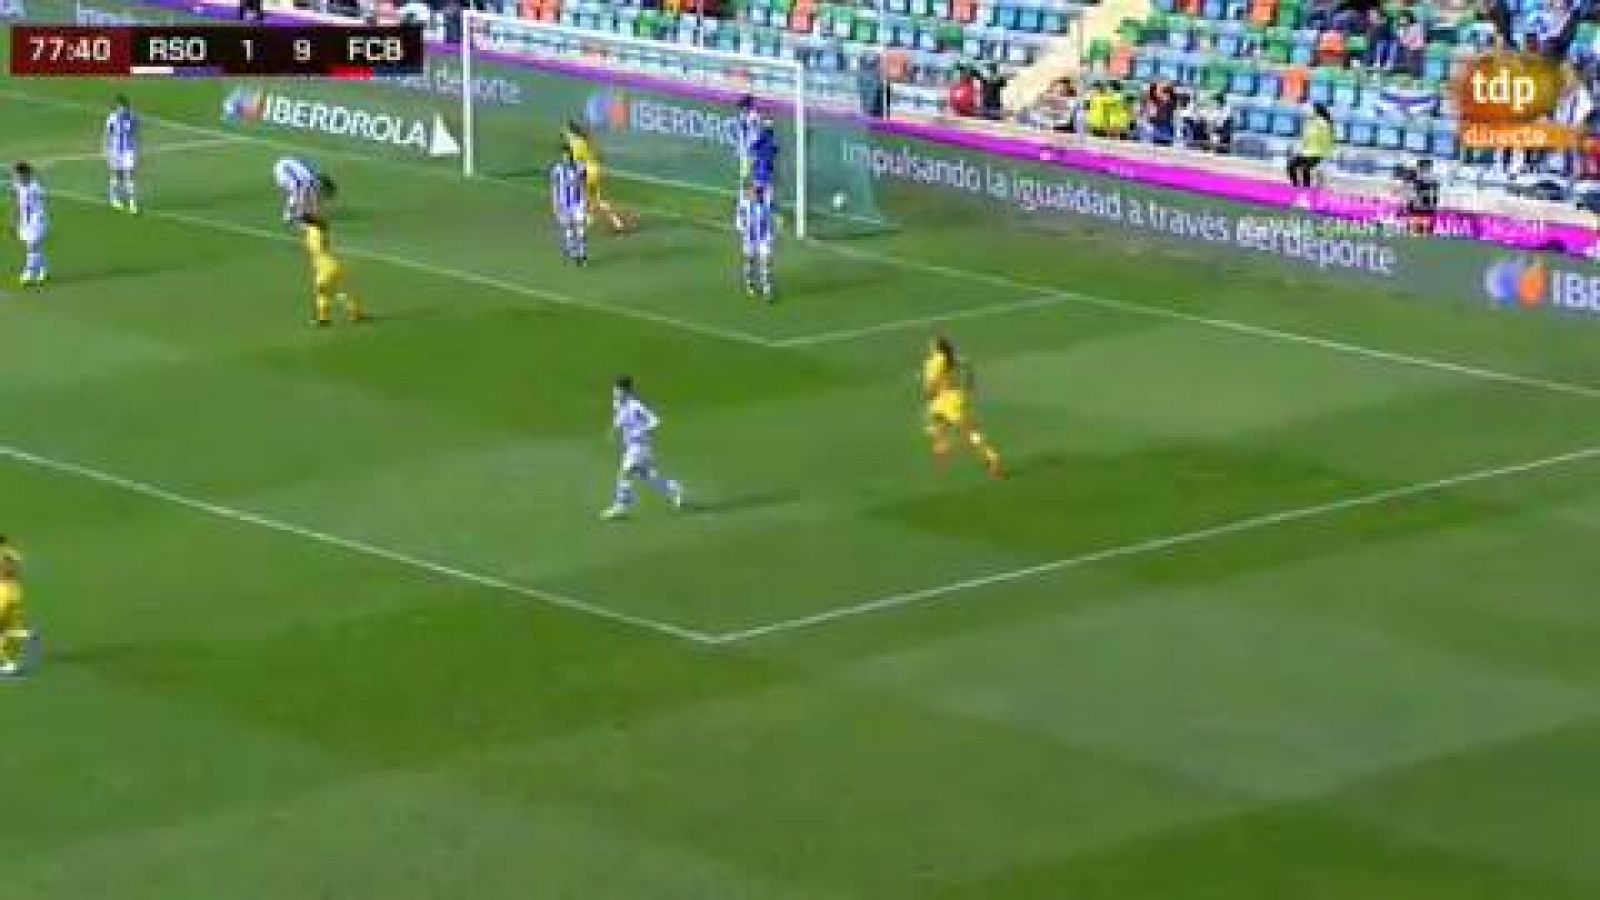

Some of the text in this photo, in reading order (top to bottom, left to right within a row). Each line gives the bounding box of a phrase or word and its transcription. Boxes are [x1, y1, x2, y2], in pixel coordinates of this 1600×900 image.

[260, 92, 429, 149] IBERDROLA
[630, 99, 741, 147] IBERDRO
[842, 138, 982, 192] Impulsando
[985, 163, 1009, 198] la
[1012, 174, 1122, 220] igualdad
[1129, 199, 1145, 224] a
